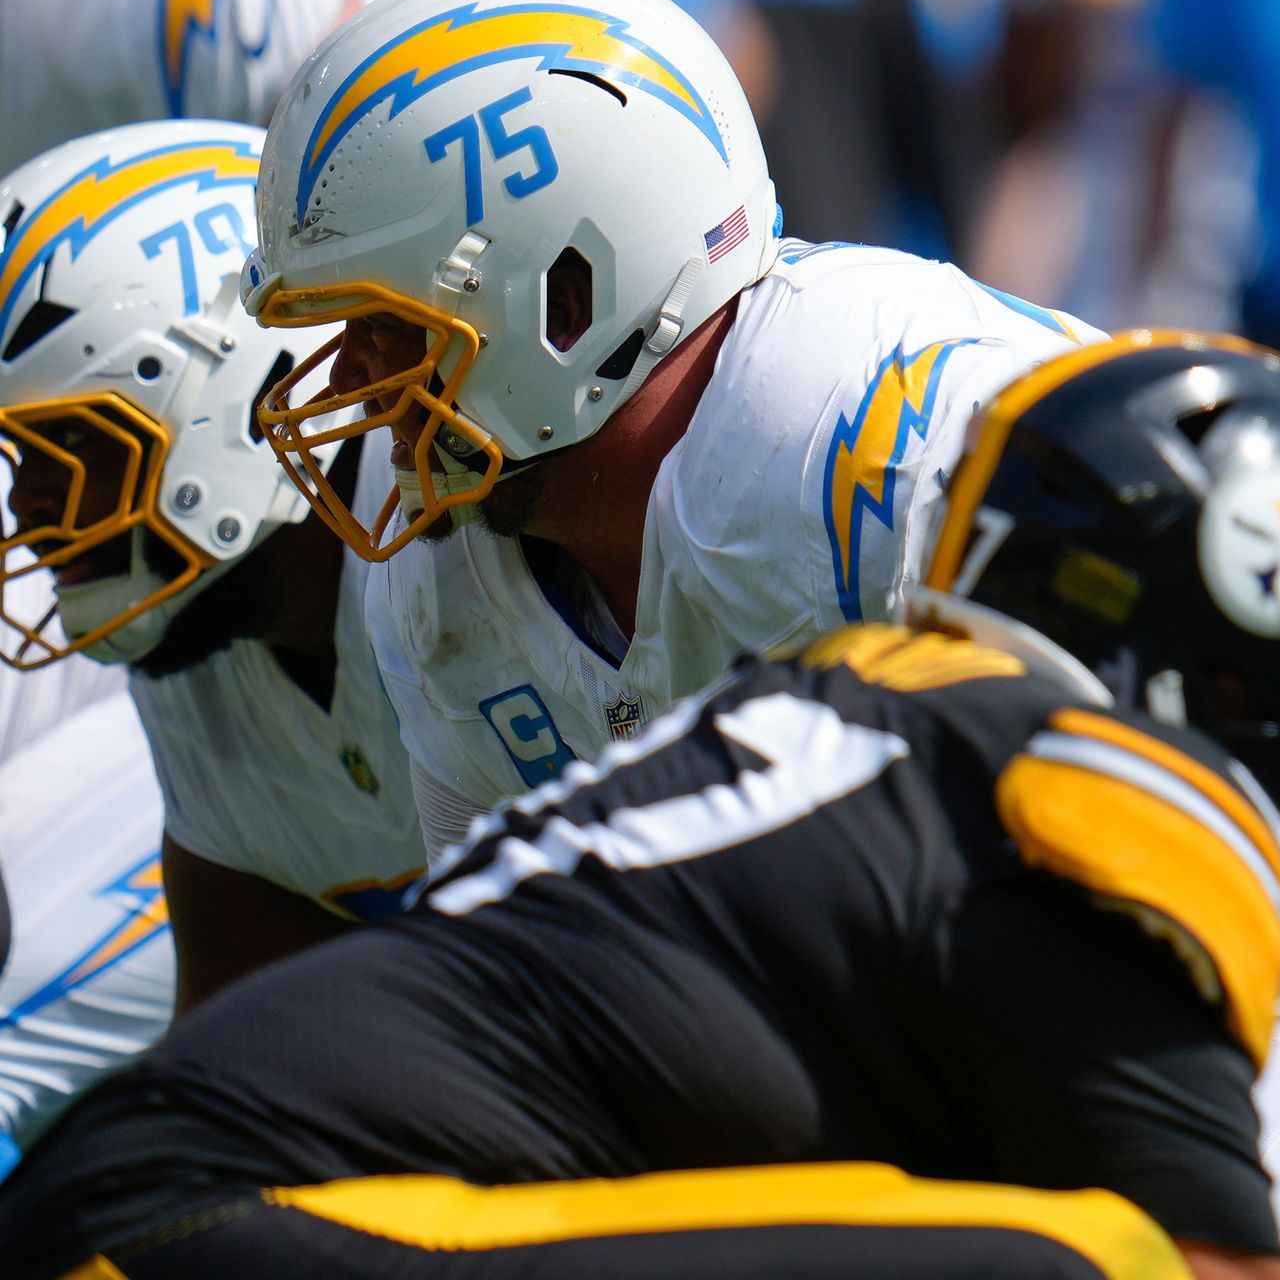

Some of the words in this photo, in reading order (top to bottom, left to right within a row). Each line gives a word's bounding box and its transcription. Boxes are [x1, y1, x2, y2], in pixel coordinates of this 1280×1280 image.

[423, 86, 559, 225] 75
[138, 202, 257, 317] 79
[489, 692, 558, 763] C
